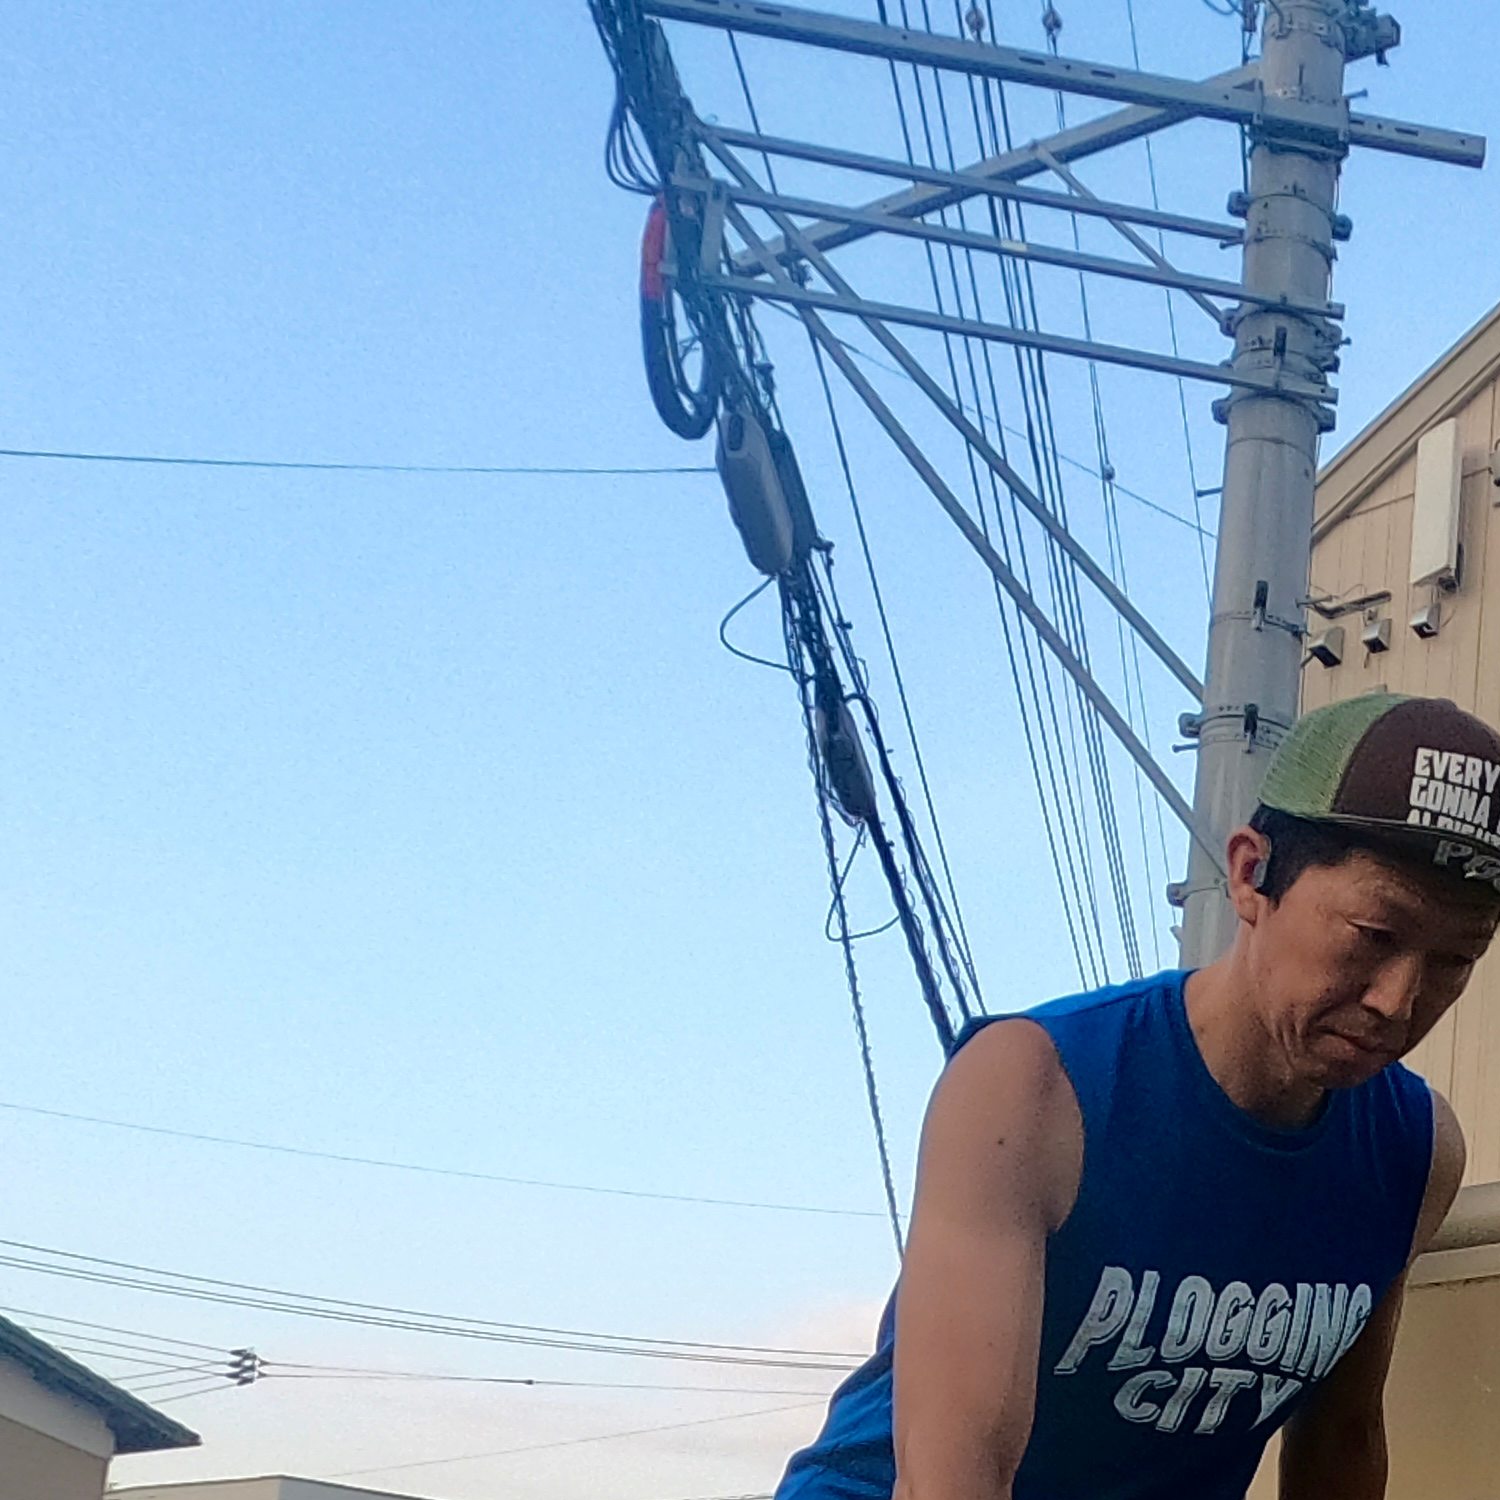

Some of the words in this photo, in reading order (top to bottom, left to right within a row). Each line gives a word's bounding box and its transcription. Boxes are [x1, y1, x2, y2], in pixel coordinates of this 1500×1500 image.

[1410, 776, 1491, 828] GONNA
[1053, 1265, 1372, 1382] PLOGGING
[1113, 1367, 1303, 1434] CITY
